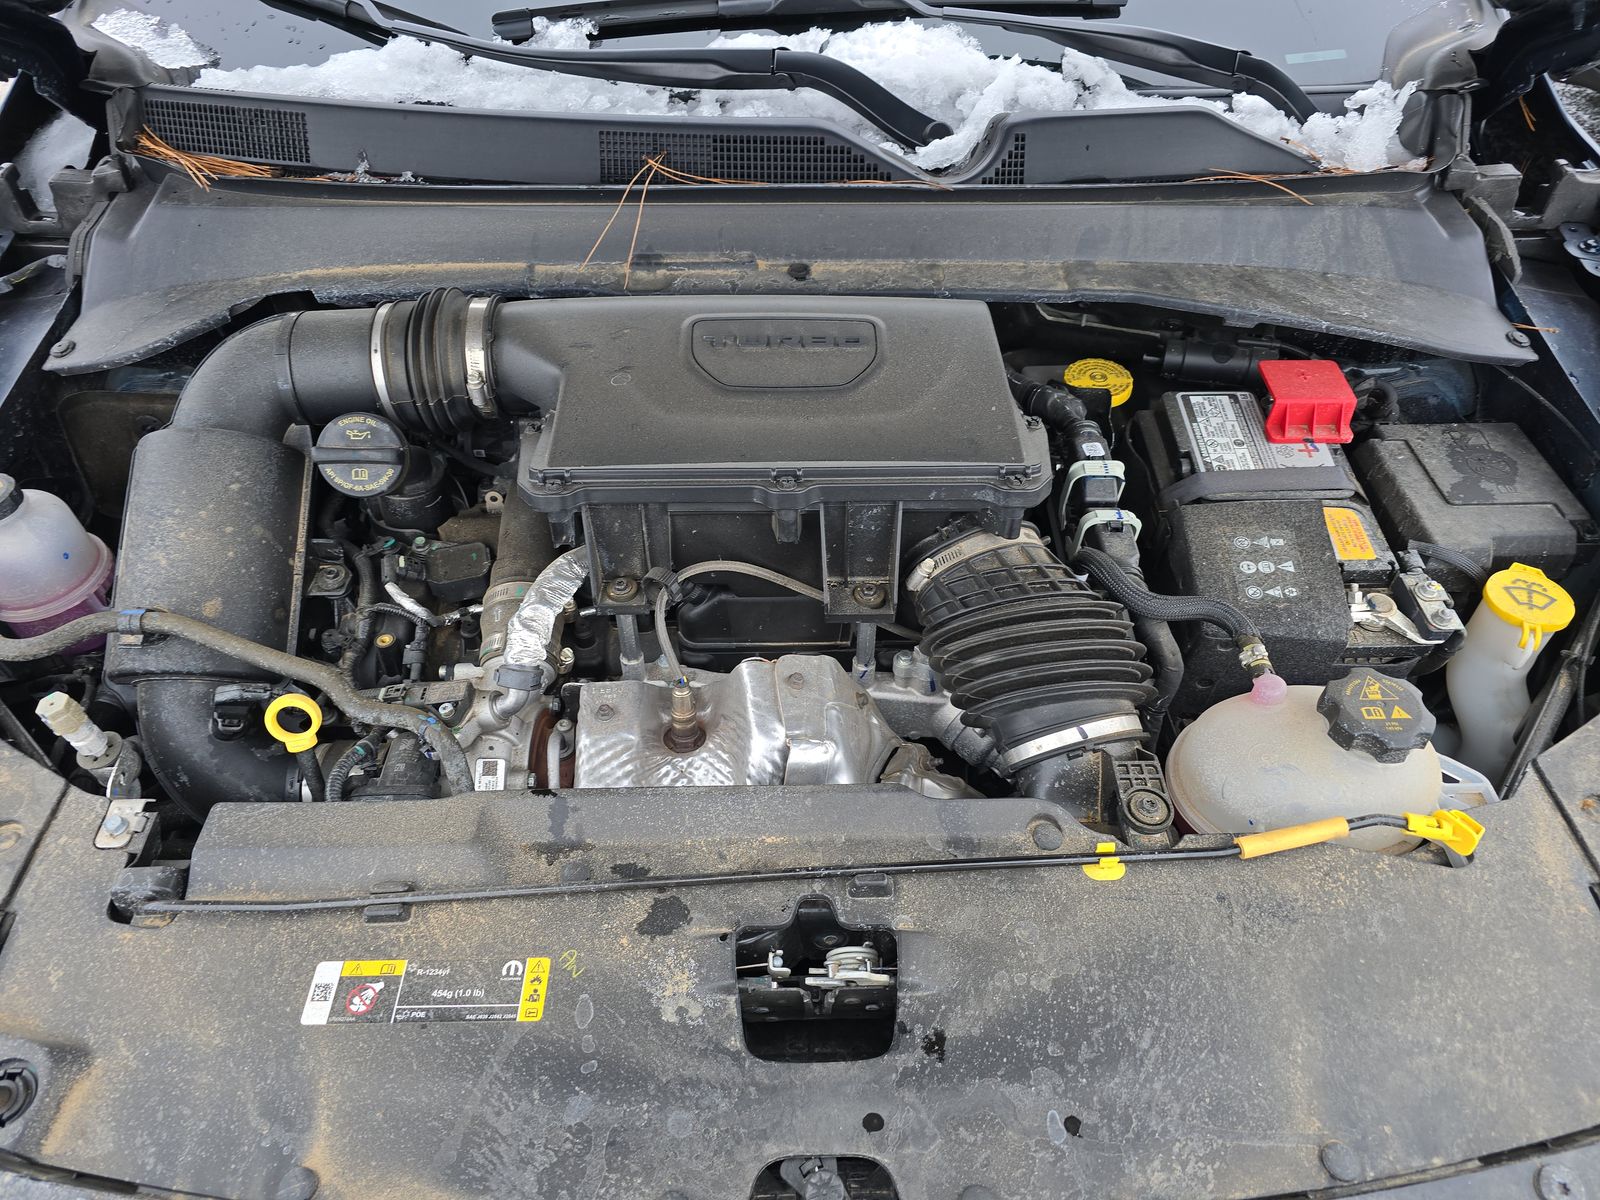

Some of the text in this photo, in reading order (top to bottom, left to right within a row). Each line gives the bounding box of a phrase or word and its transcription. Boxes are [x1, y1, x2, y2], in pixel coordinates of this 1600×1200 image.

[338, 416, 377, 427] ENGINE OIL
[431, 988, 485, 999] 454g (1.0 lb)
